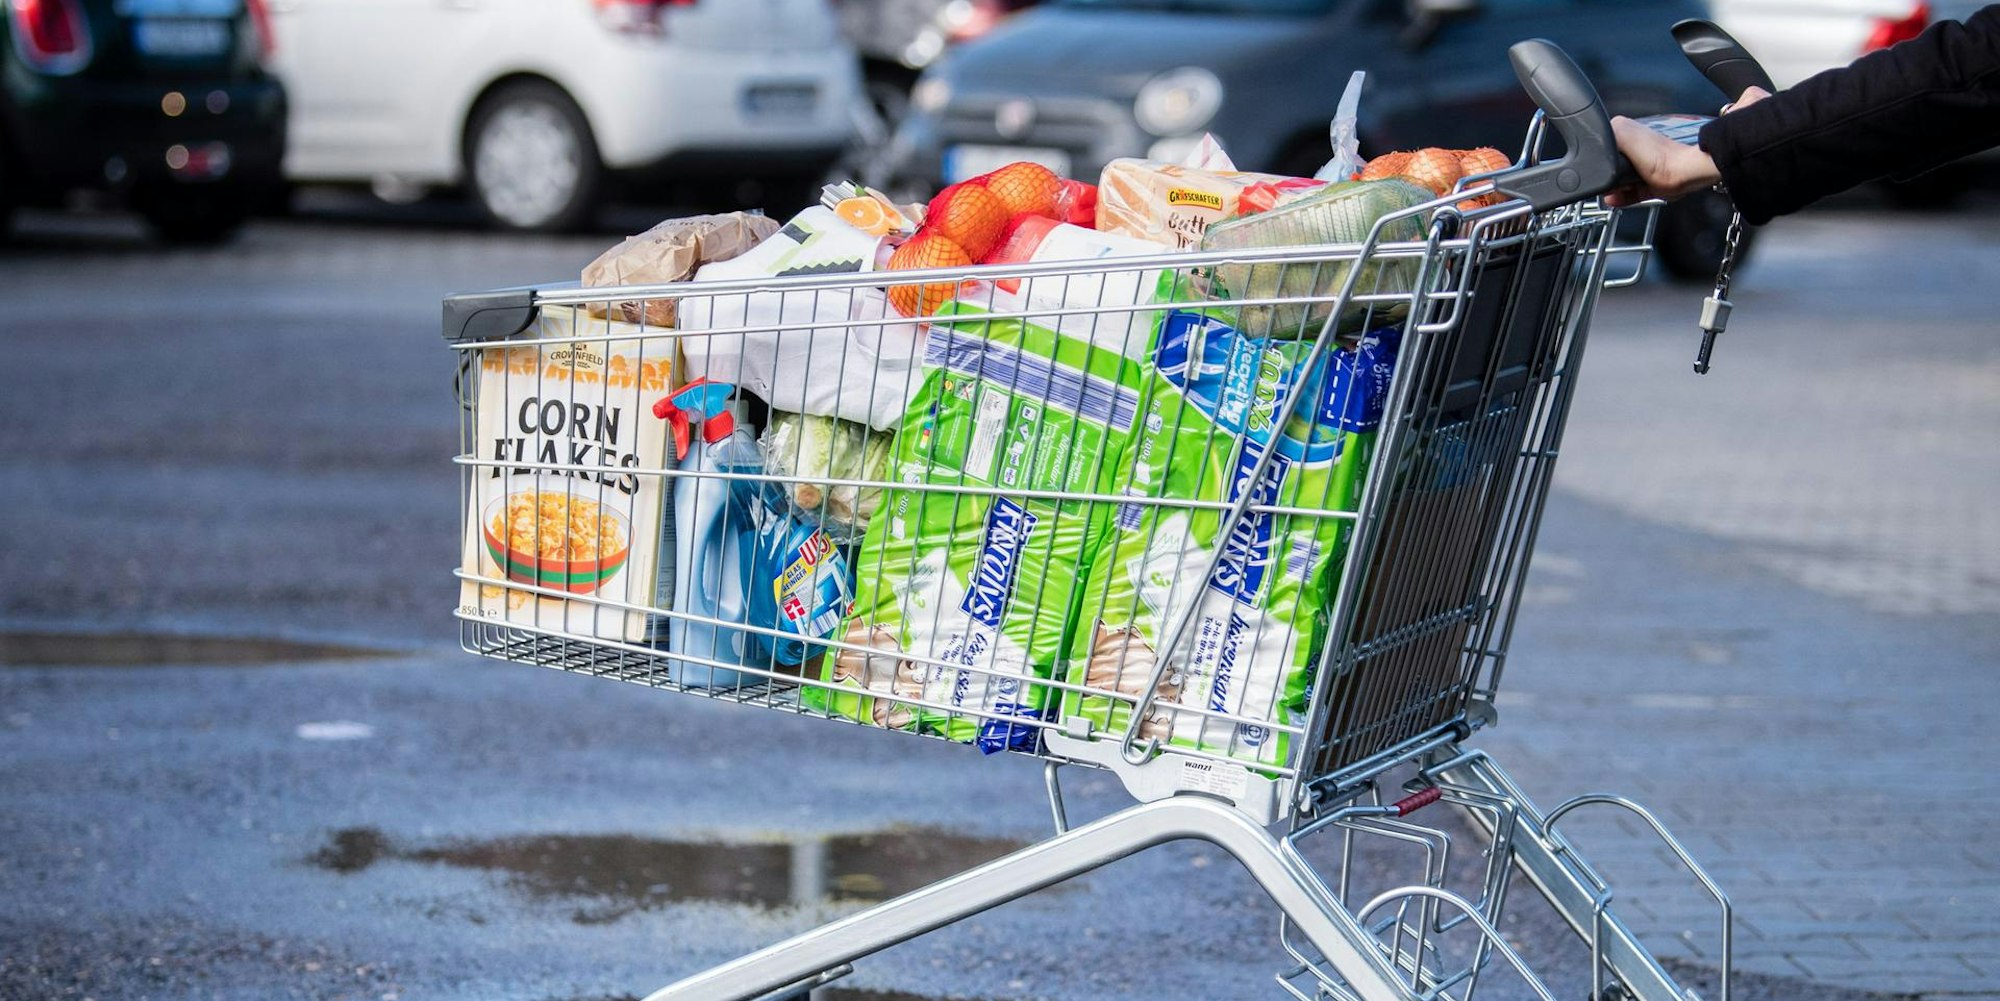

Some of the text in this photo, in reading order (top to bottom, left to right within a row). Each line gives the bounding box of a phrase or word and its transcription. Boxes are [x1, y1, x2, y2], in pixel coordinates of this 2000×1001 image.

[1247, 349, 1282, 431] 100%
[518, 397, 621, 445] CORN
[492, 438, 639, 495] FLAKES
[461, 605, 477, 616] 850
[1184, 760, 1212, 772] wanzl
